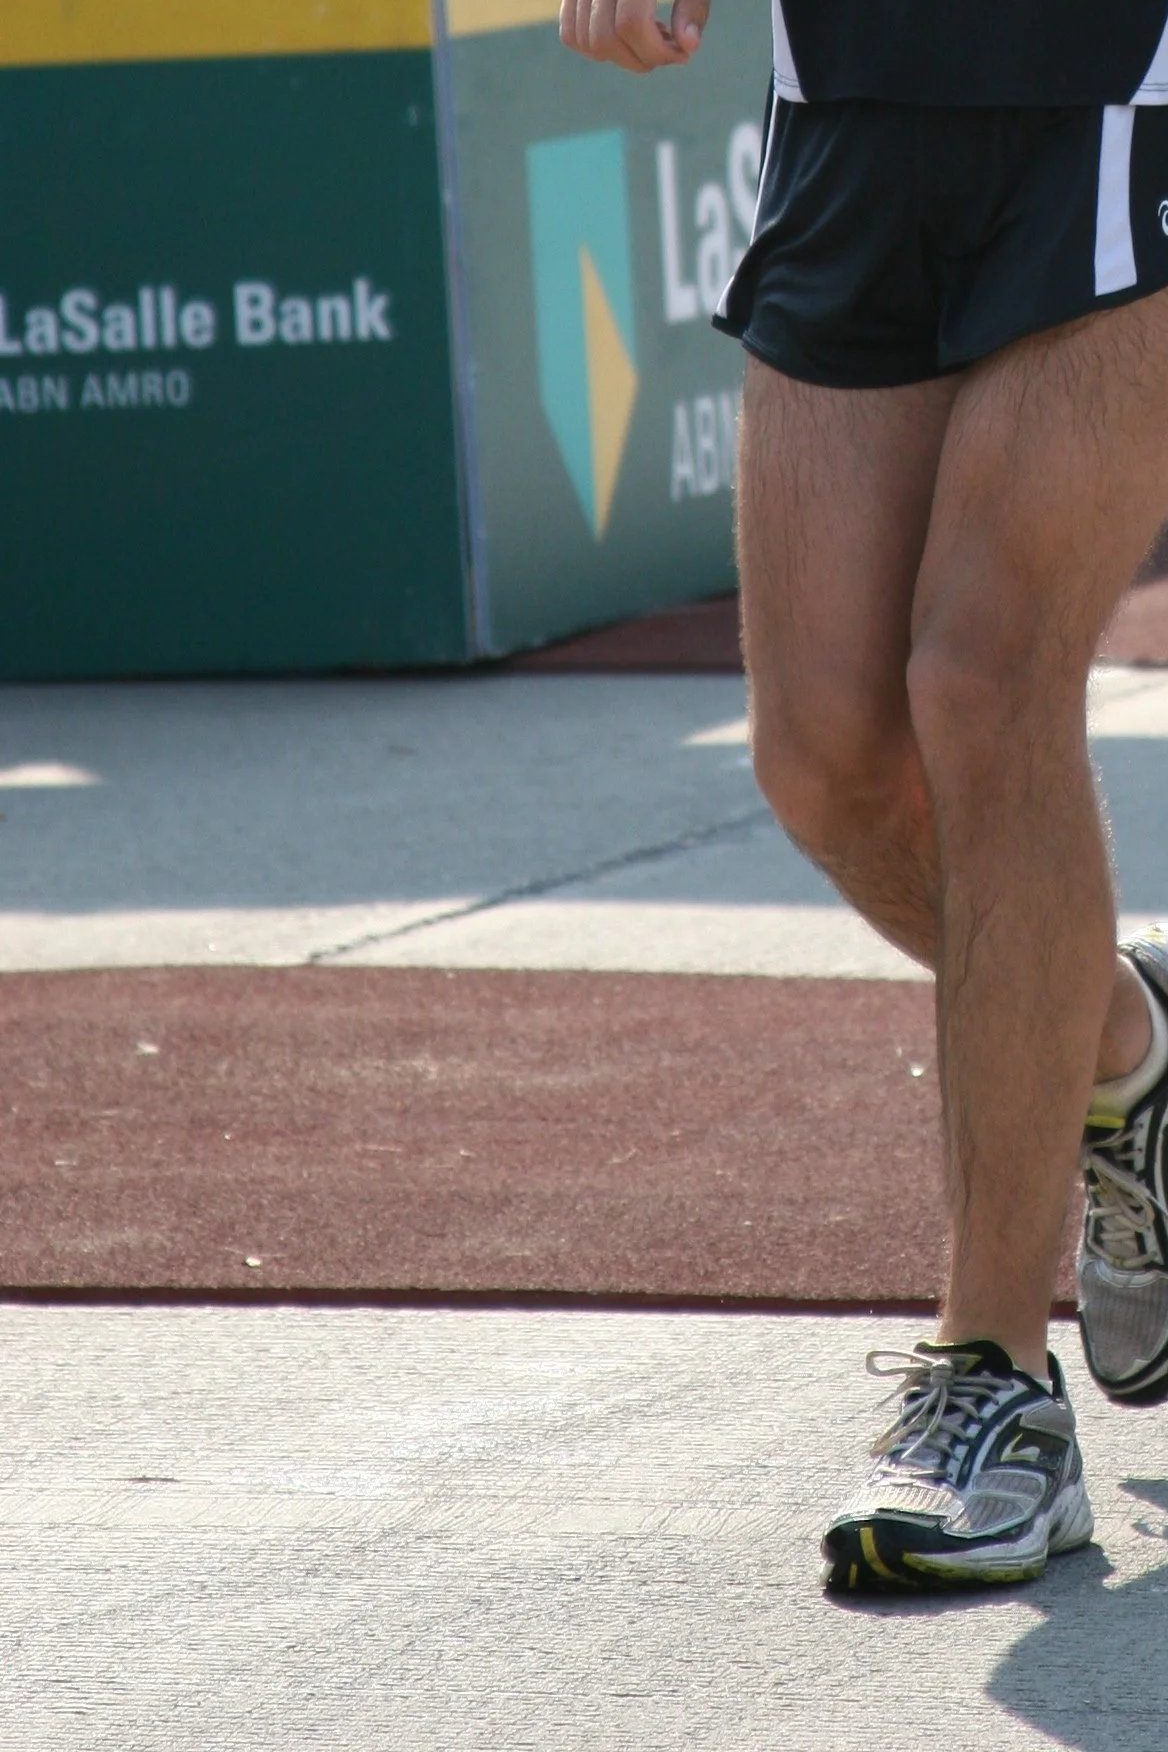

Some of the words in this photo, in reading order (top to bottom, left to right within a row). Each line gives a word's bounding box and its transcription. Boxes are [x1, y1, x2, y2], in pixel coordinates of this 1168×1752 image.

[0, 283, 216, 356] LaSalle
[232, 275, 395, 347] Bank
[80, 366, 191, 412] AMRO
